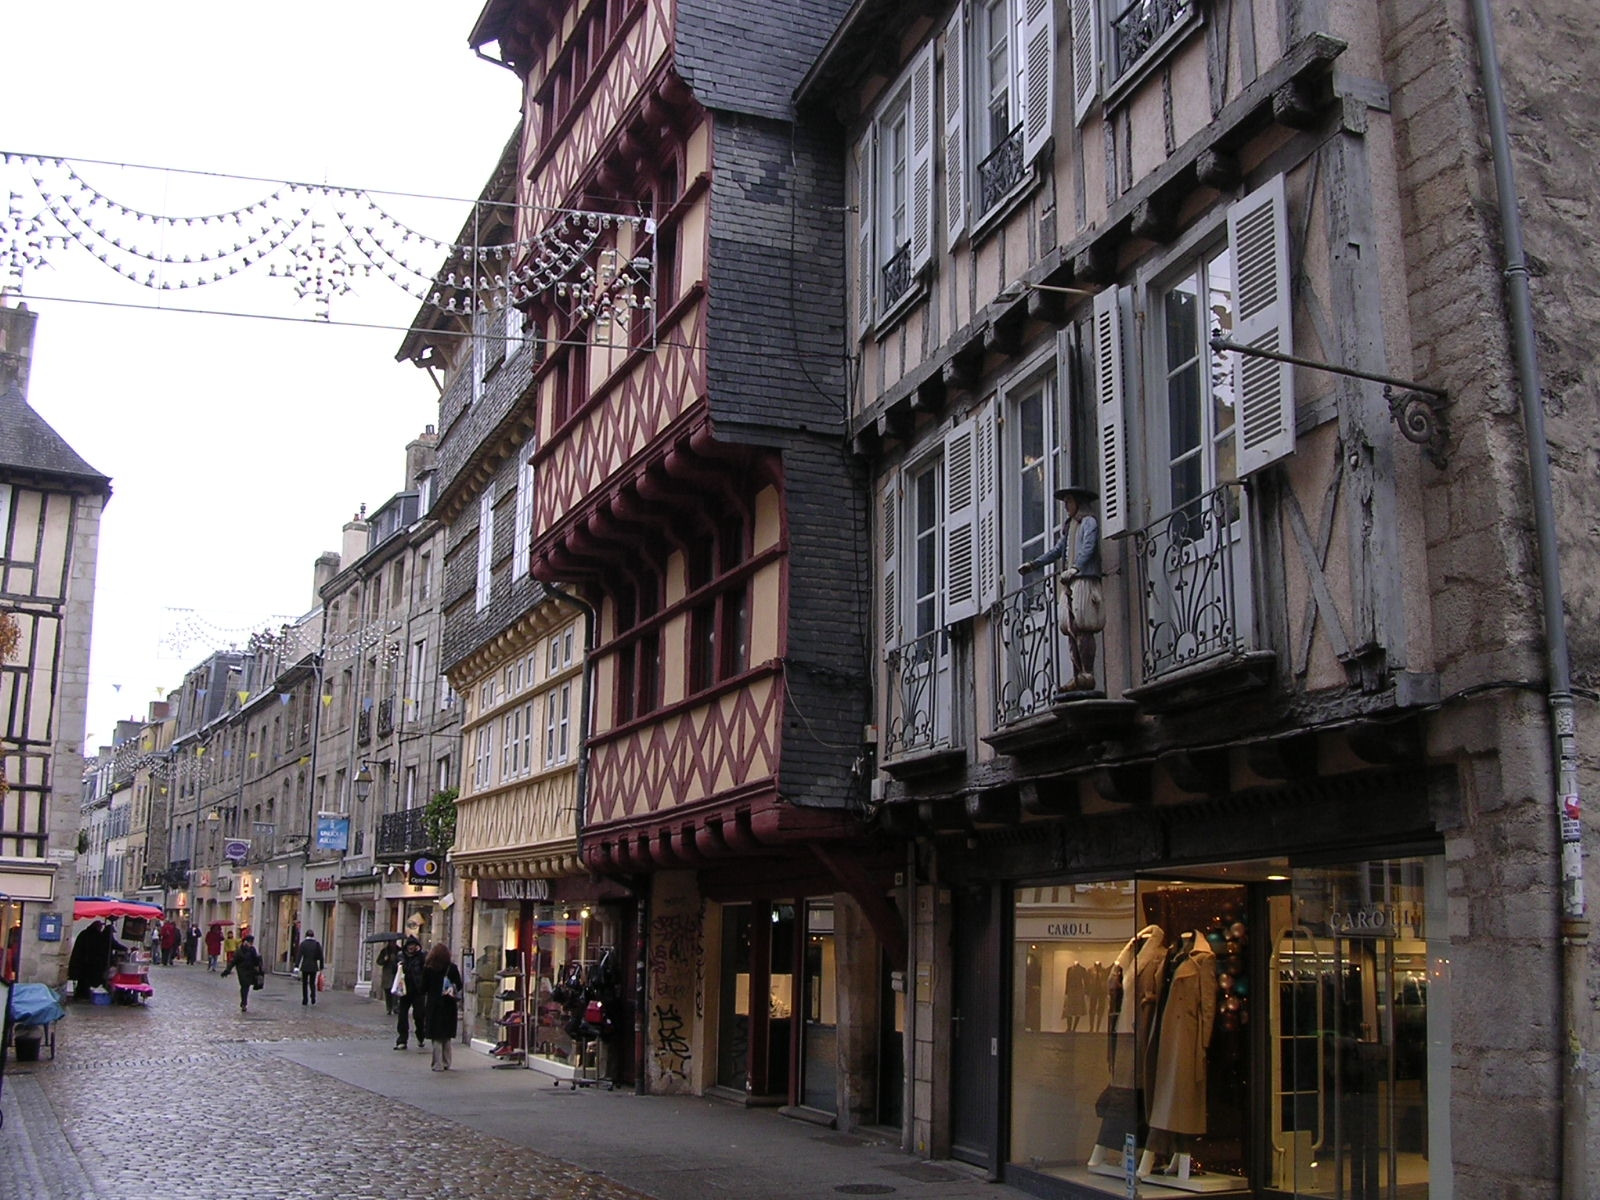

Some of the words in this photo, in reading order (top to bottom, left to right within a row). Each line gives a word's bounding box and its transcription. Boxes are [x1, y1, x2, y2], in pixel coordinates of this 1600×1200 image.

[526, 879, 548, 900] ARNO
[1047, 923, 1092, 936] CAROLL
[1330, 909, 1412, 930] CAROLL
